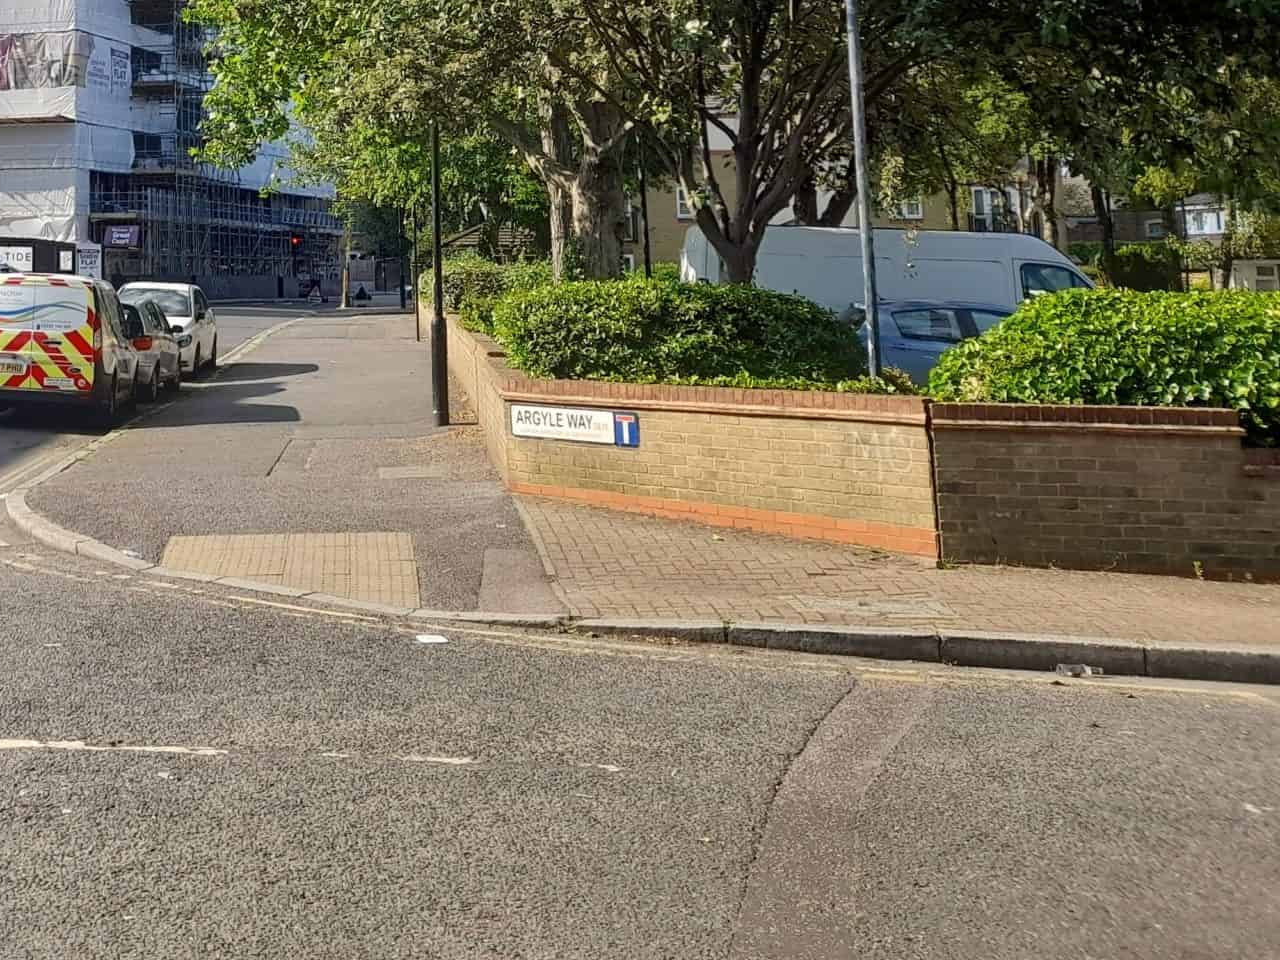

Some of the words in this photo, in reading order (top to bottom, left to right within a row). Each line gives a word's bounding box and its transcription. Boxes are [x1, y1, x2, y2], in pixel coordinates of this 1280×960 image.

[5, 252, 31, 262] TIDE
[516, 410, 564, 428] ARGYLE
[567, 413, 593, 430] WAY
